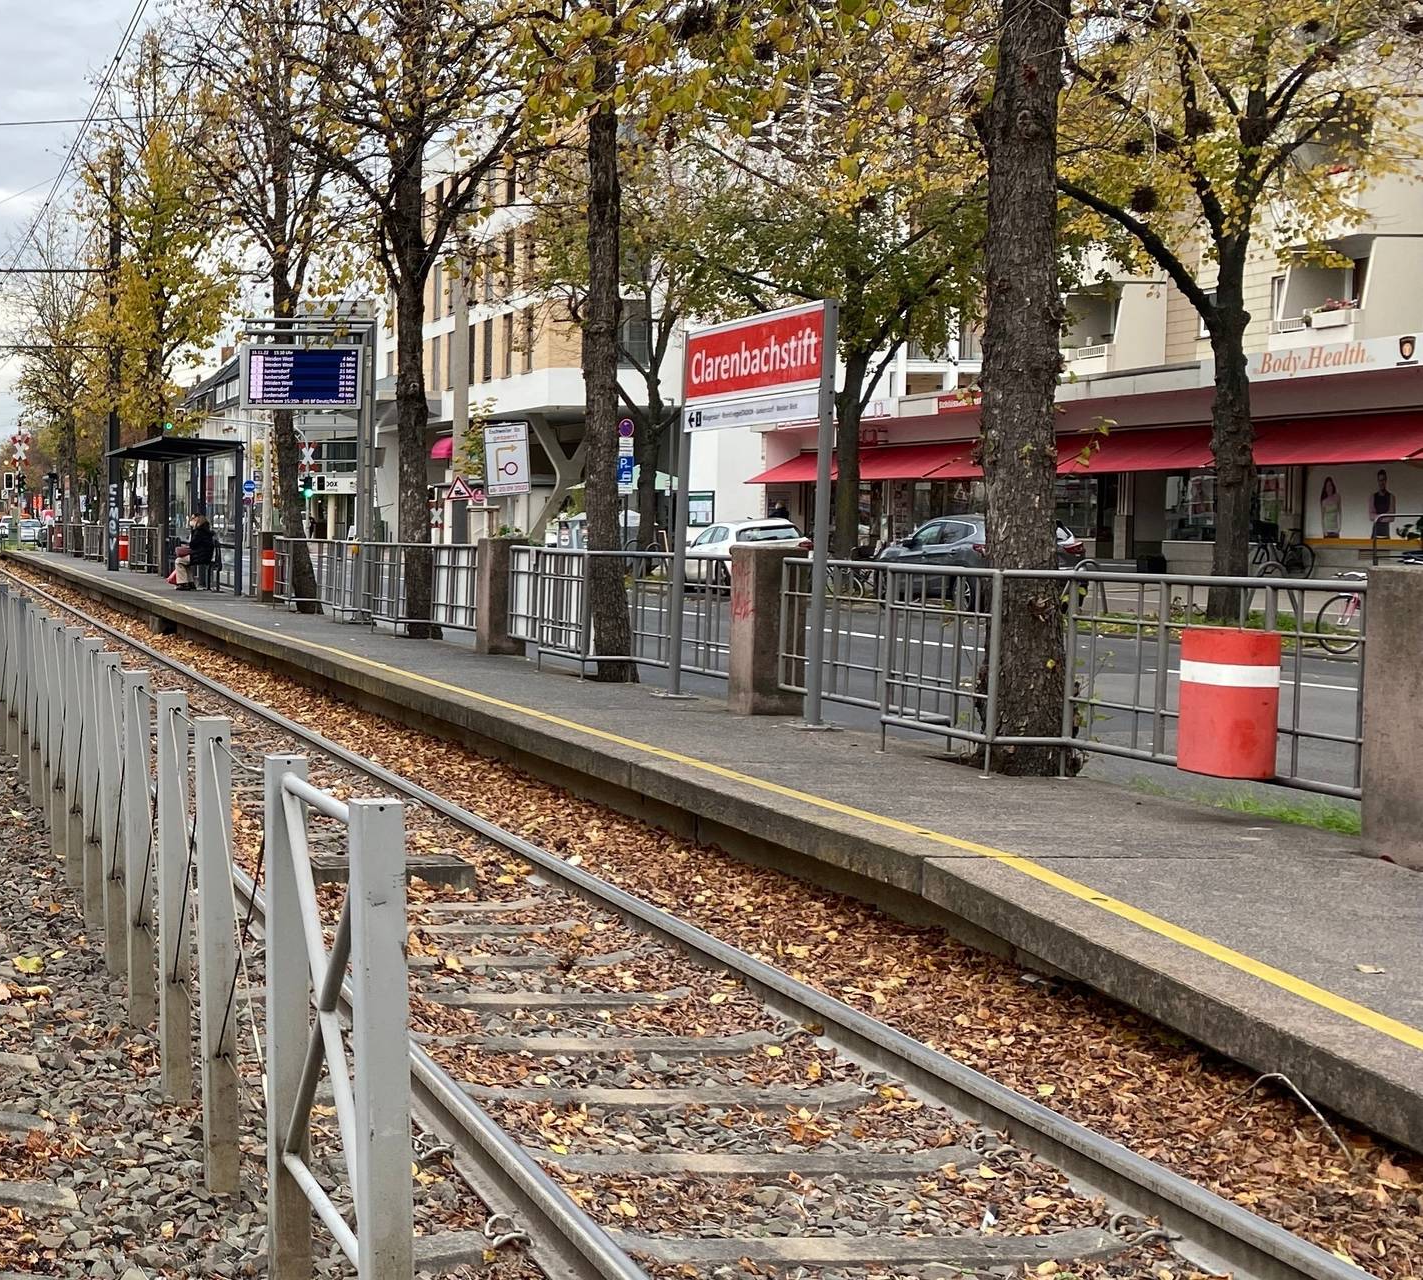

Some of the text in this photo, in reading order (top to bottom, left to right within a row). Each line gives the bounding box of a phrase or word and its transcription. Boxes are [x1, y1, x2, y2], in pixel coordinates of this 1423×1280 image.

[691, 326, 818, 385] Clarenbachstift
[1260, 350, 1301, 377] Body
[1306, 342, 1367, 370] Health
[620, 458, 628, 469] P
